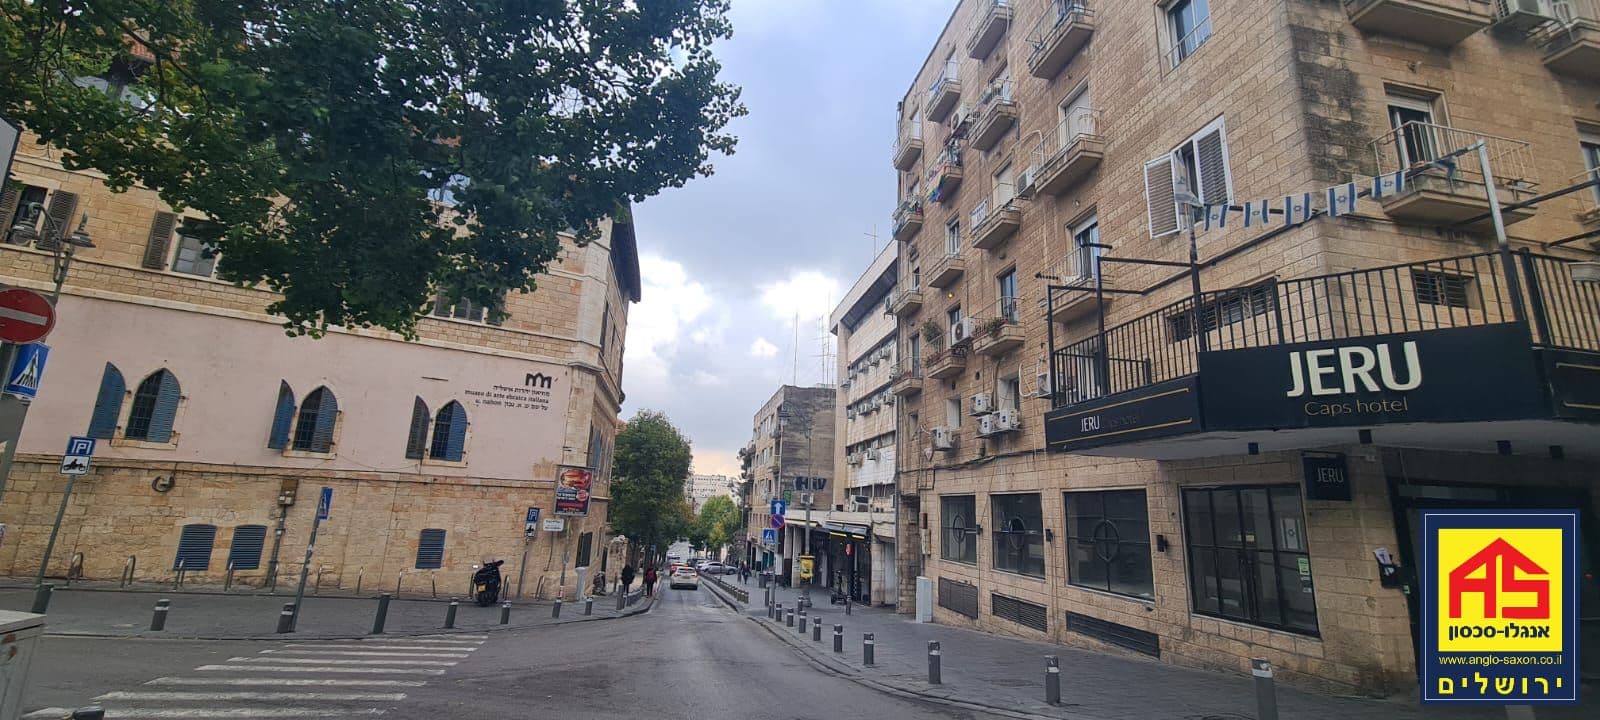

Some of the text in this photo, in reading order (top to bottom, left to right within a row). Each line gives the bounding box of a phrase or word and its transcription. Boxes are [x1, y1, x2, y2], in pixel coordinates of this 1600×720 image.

[1287, 341, 1422, 397] JERU
[1304, 396, 1408, 417] Caps hotel
[1080, 415, 1100, 433] JERU
[1316, 467, 1344, 483] JERU
